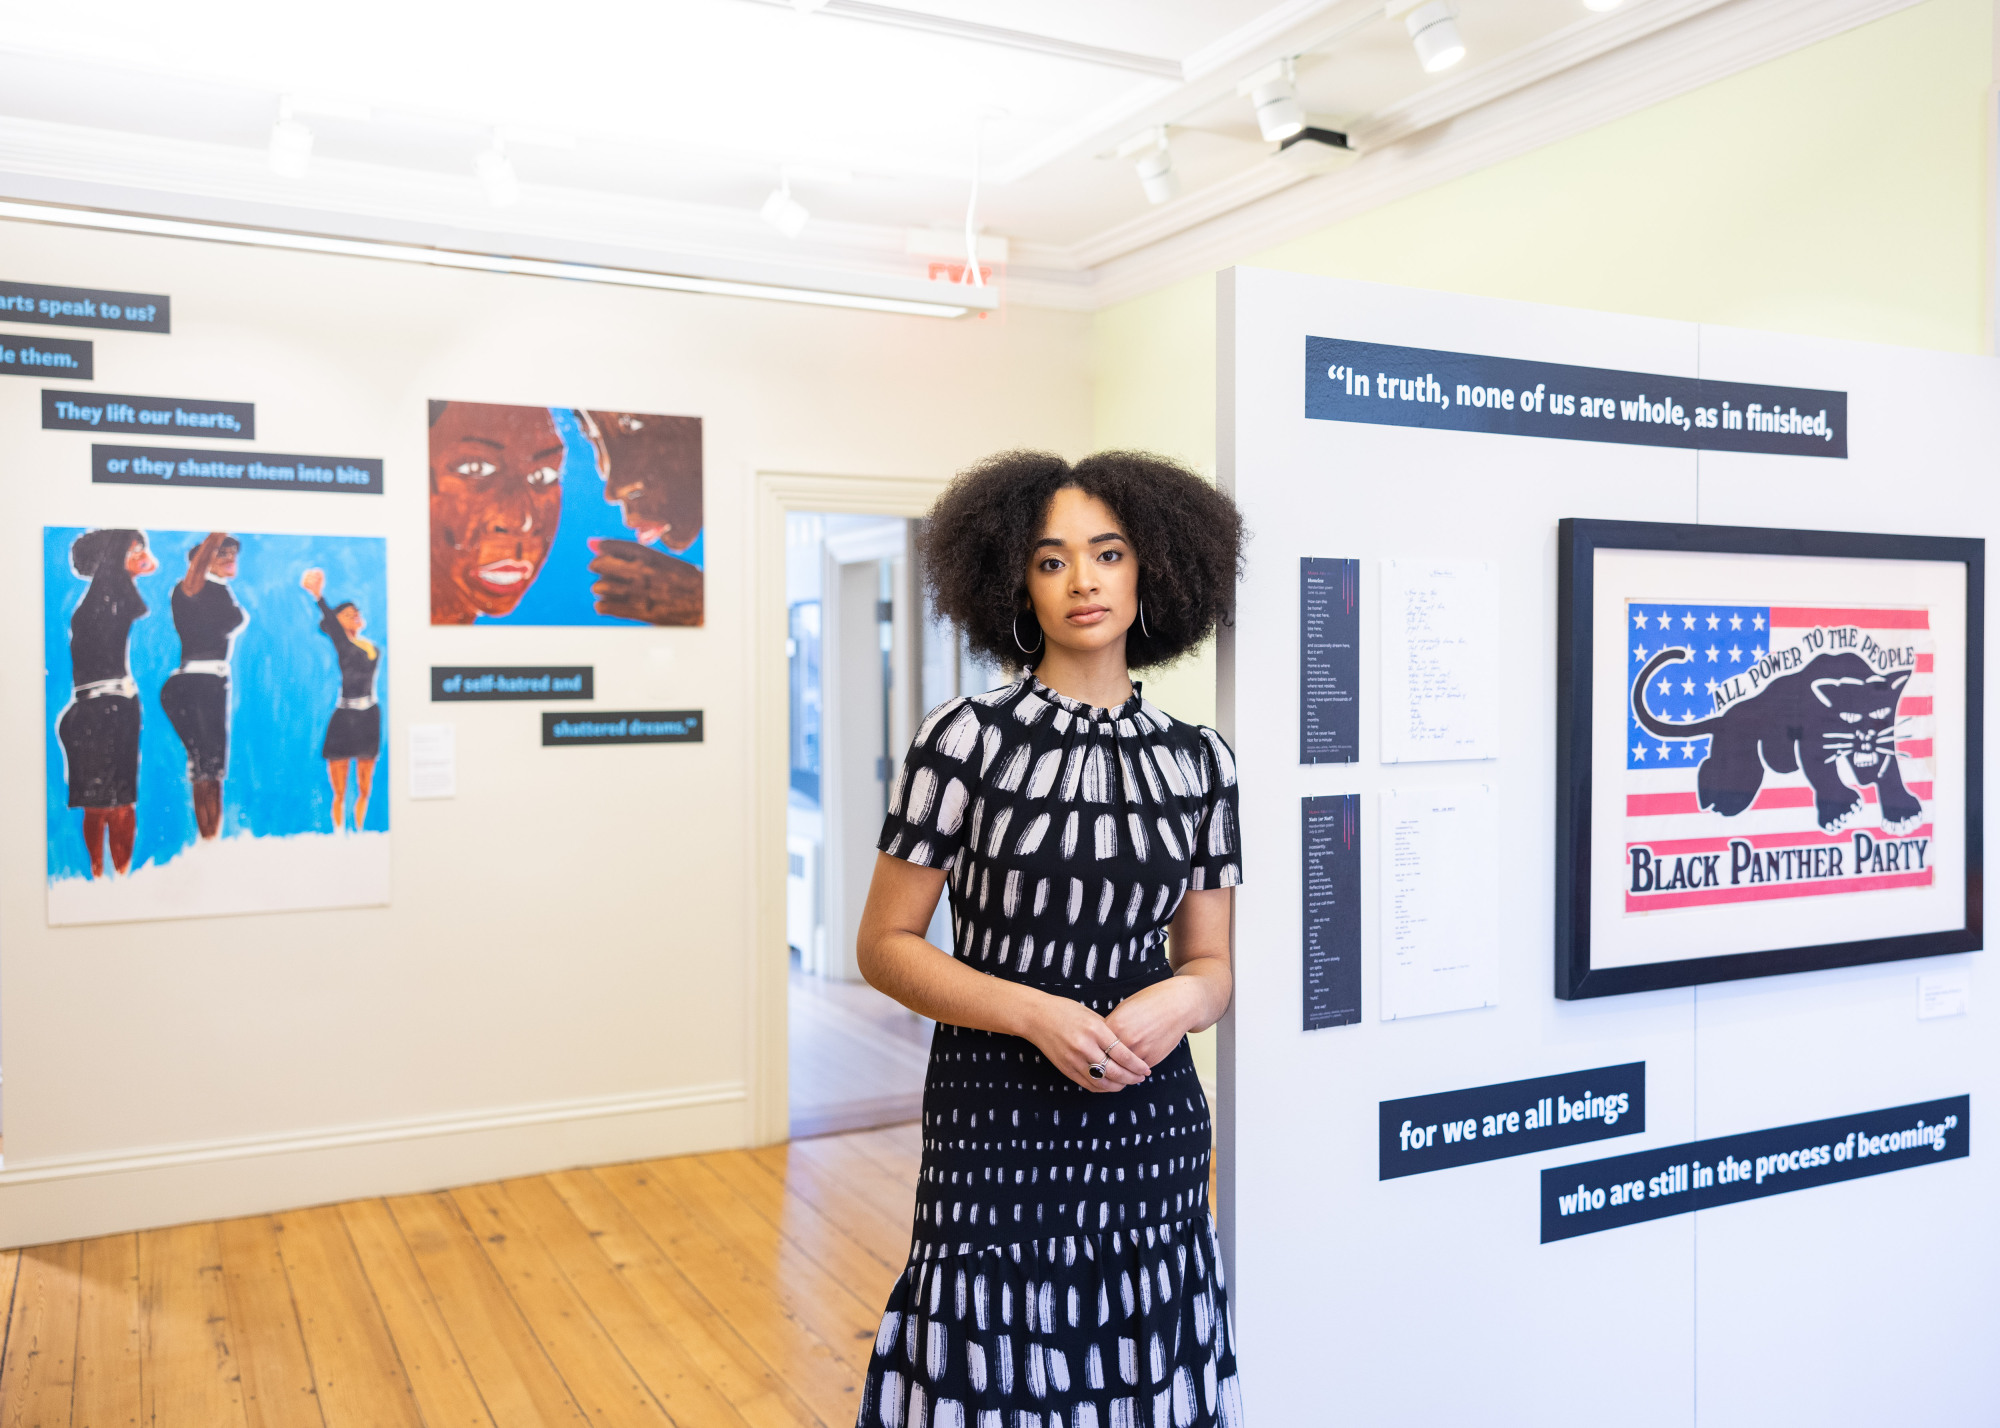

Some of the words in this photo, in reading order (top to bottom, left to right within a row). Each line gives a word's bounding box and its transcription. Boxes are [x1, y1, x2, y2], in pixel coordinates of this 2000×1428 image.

[38, 298, 97, 319] speak
[99, 302, 122, 320] to
[124, 305, 157, 323] us?
[19, 346, 79, 369] them.
[54, 401, 103, 426] They
[105, 403, 136, 424] lift
[138, 409, 174, 426] our
[175, 407, 241, 433] hearts,
[1328, 363, 1370, 396] “In
[1376, 369, 1451, 411] truth,
[1456, 384, 1515, 412] none
[1520, 383, 1546, 413] of
[1550, 392, 1575, 415] us
[1580, 395, 1616, 420] are
[1621, 398, 1692, 432] whole,
[1694, 405, 1719, 429] as
[1722, 402, 1743, 430] in
[1746, 404, 1833, 441] finished,
[106, 458, 130, 474] or
[132, 456, 175, 480] they
[177, 457, 245, 480] shatter
[246, 461, 295, 482] them
[297, 463, 334, 484] into
[335, 465, 370, 485] bits
[442, 674, 463, 693] of
[463, 673, 550, 693] self-hatred
[551, 673, 582, 692] and
[1714, 681, 1747, 710] ALL
[1749, 646, 1803, 689] POWER
[1803, 627, 1825, 654] TO
[1827, 627, 1859, 650] THE
[1860, 634, 1915, 672] PEOPLE
[552, 718, 628, 738] shattered
[1399, 1119, 1438, 1152] for
[1442, 1119, 1478, 1145] we
[1482, 1111, 1520, 1138] are
[1524, 1104, 1552, 1132] all
[1557, 1090, 1630, 1126] beings
[1558, 1183, 1606, 1217] who
[1609, 1181, 1645, 1207] are
[1648, 1165, 1688, 1198] still
[1692, 1161, 1713, 1190] in
[1717, 1156, 1752, 1186] the
[1755, 1142, 1832, 1185] process
[1834, 1133, 1856, 1162] of
[1857, 1114, 1958, 1161] becoming”
